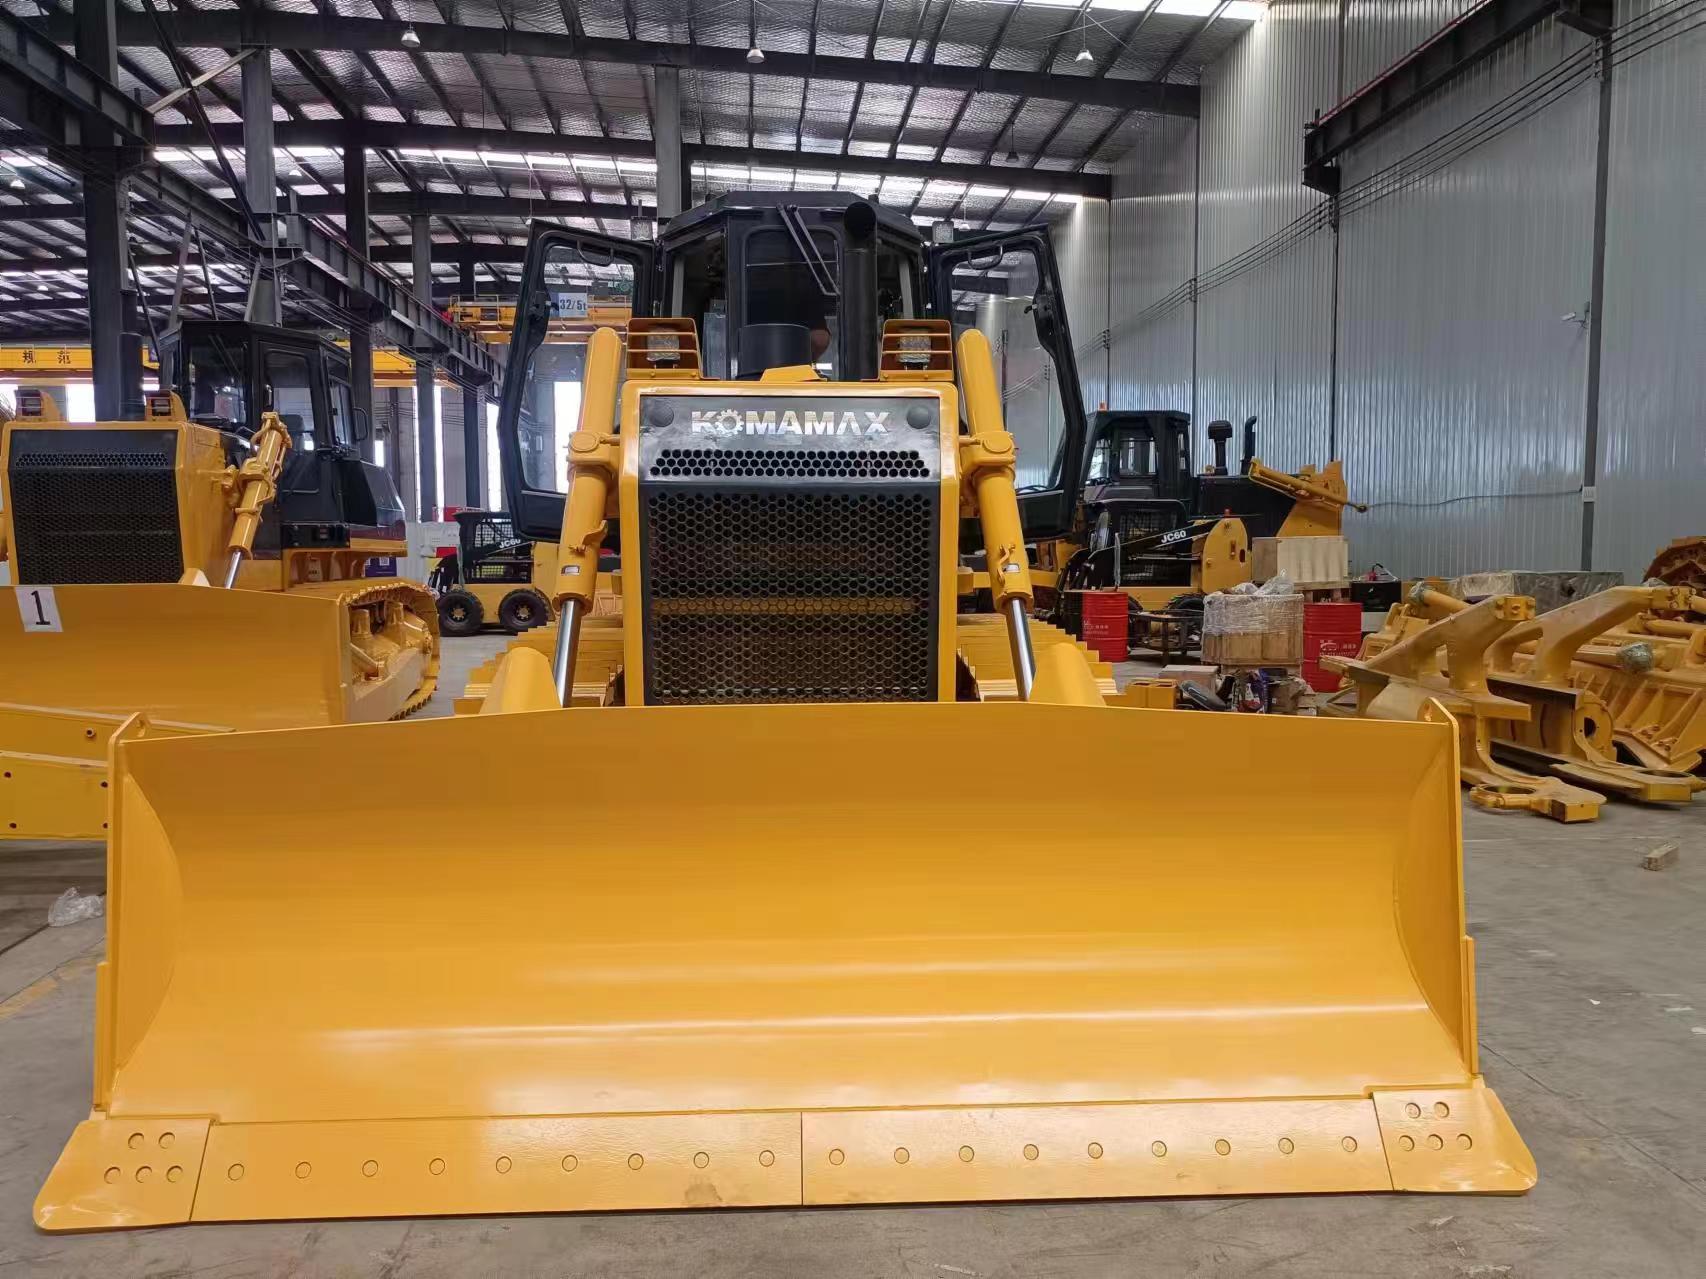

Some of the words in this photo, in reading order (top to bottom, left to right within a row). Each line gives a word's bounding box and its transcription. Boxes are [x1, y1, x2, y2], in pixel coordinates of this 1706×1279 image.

[559, 299, 587, 311] 32/5t
[691, 408, 890, 436] KOMAMAX
[1160, 530, 1187, 544] JC60
[31, 590, 51, 625] 1
